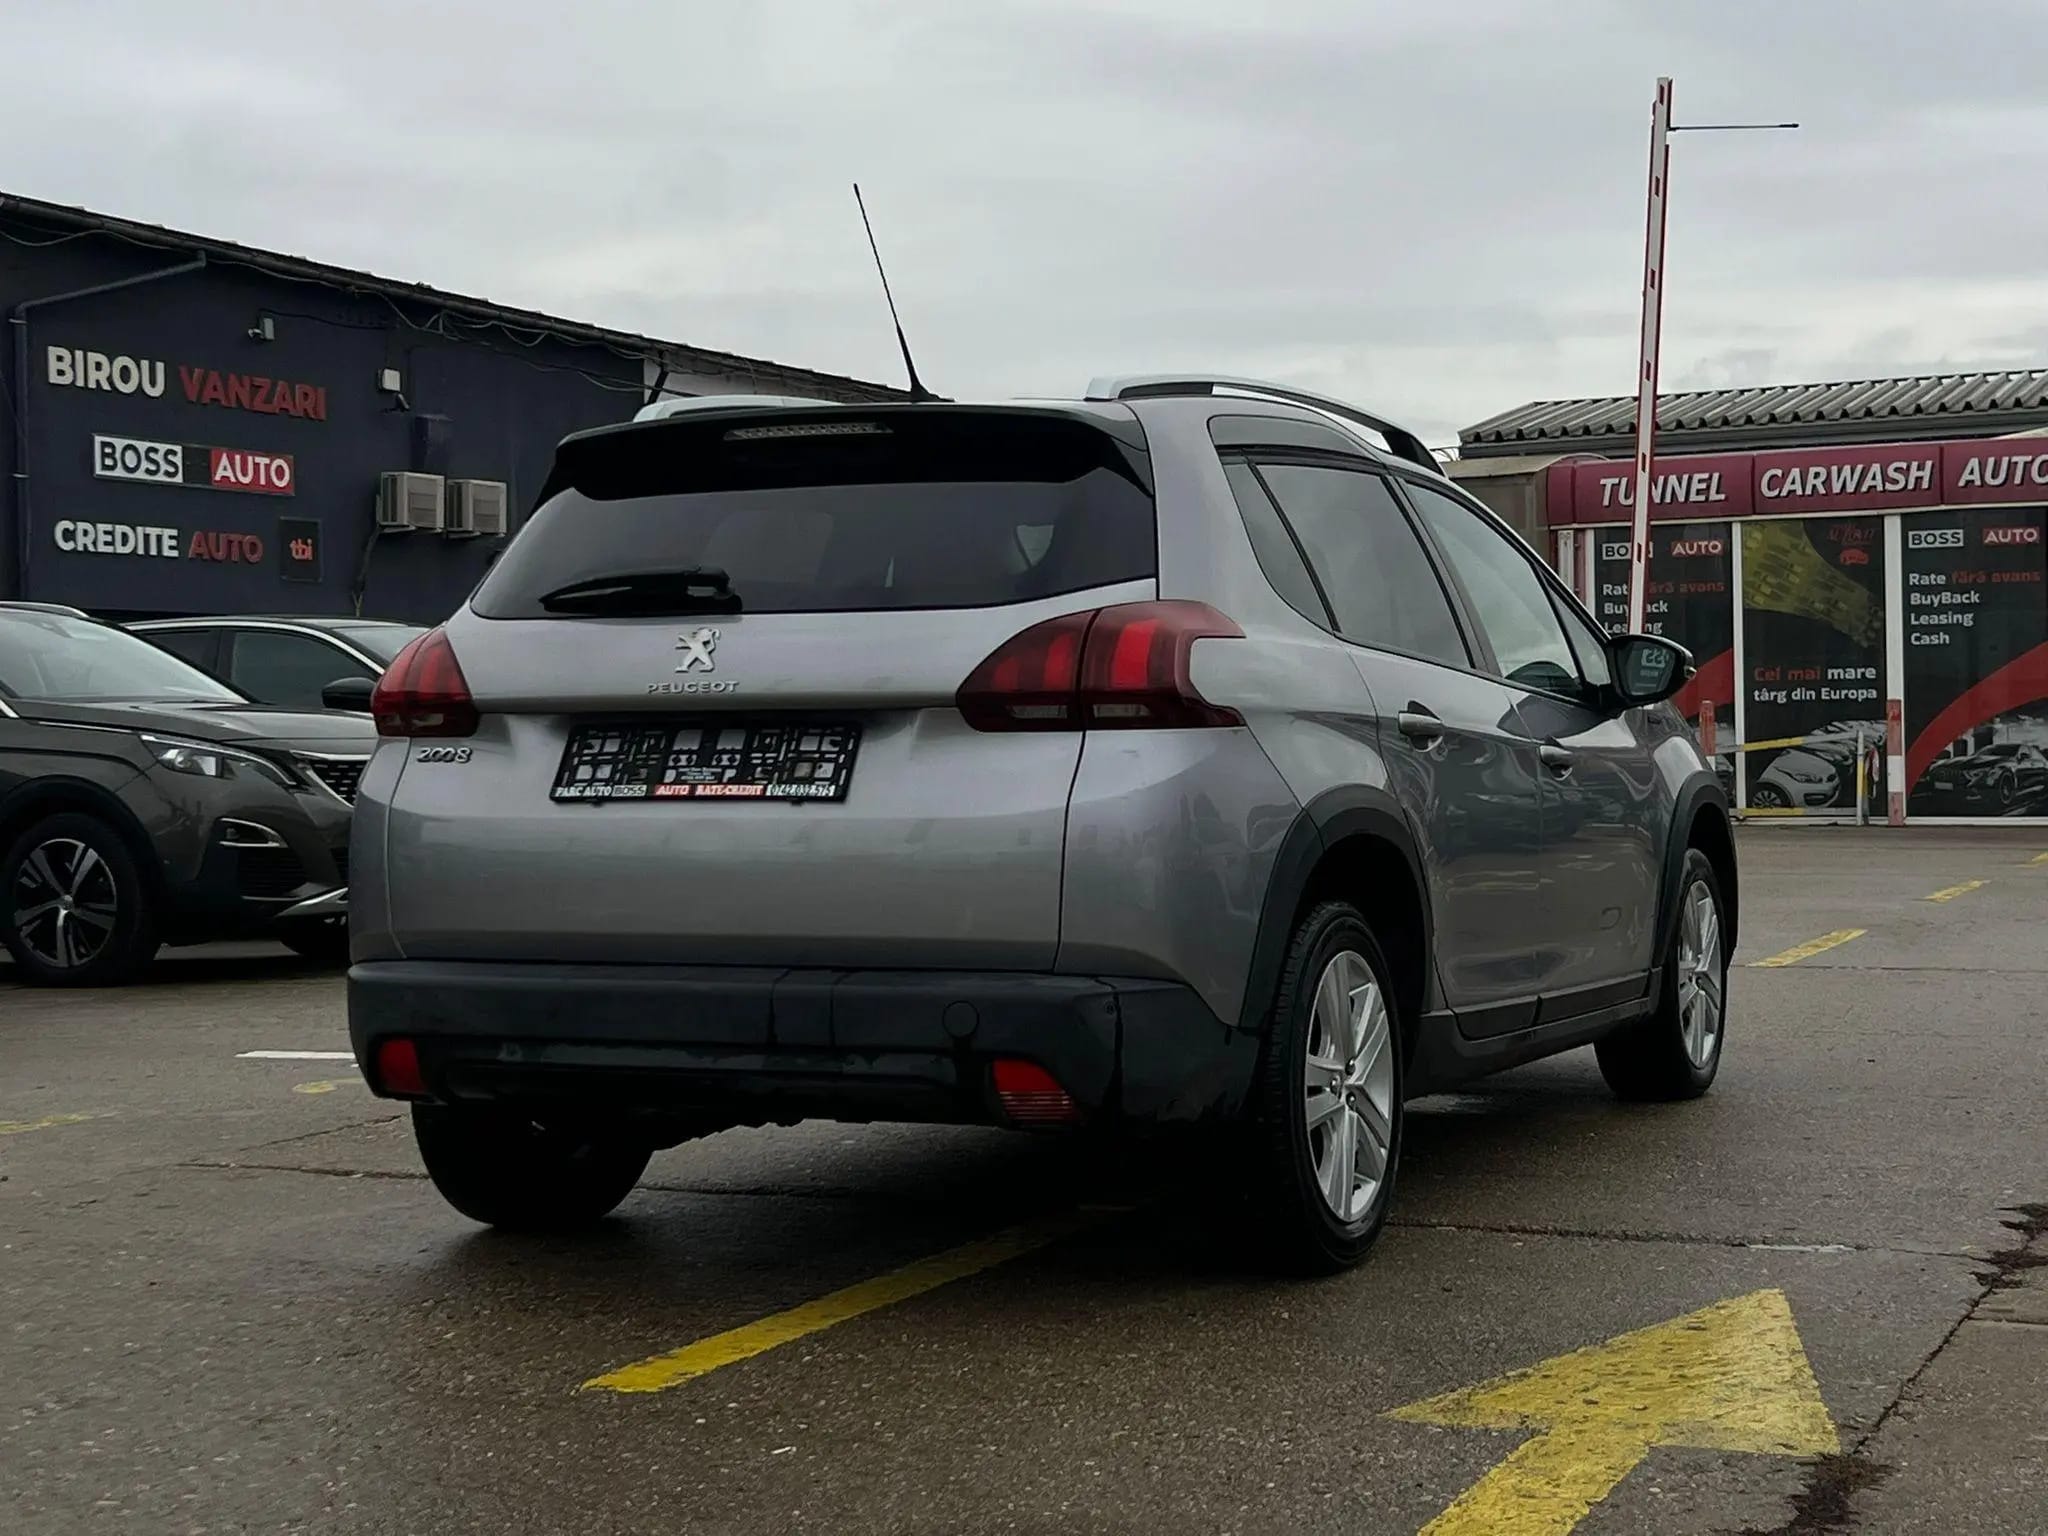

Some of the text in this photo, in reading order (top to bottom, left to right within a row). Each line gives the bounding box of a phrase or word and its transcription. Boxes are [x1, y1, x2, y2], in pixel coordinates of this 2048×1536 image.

[47, 345, 327, 420] BIROU VANZARI
[100, 441, 291, 488] BOSS AUTO
[1760, 461, 1934, 498] CARWASH
[1958, 454, 2048, 487] AUTO
[54, 520, 264, 563] CREDITE AUTO
[1911, 528, 2039, 545] BOSS AUTO
[289, 538, 313, 561] tbi
[1604, 541, 1723, 558] BO AUTO
[1909, 573, 1947, 586] Rate
[1991, 571, 2041, 583] avans
[1603, 584, 1631, 596] Rat
[1679, 580, 1725, 593] avans
[1910, 591, 1980, 607] BuyBack
[1604, 600, 1669, 616] Buyack
[1910, 611, 1975, 627] Leasing
[1604, 621, 1663, 635] Leang
[1911, 632, 1950, 645] Cash
[1754, 666, 1877, 681] Cel mai mare
[648, 680, 739, 694] PEUGEOT
[1791, 687, 1816, 701] din
[1820, 687, 1878, 702] Europa
[416, 747, 473, 765] 2008
[583, 786, 612, 797] AUTO
[654, 784, 690, 796] AUTO
